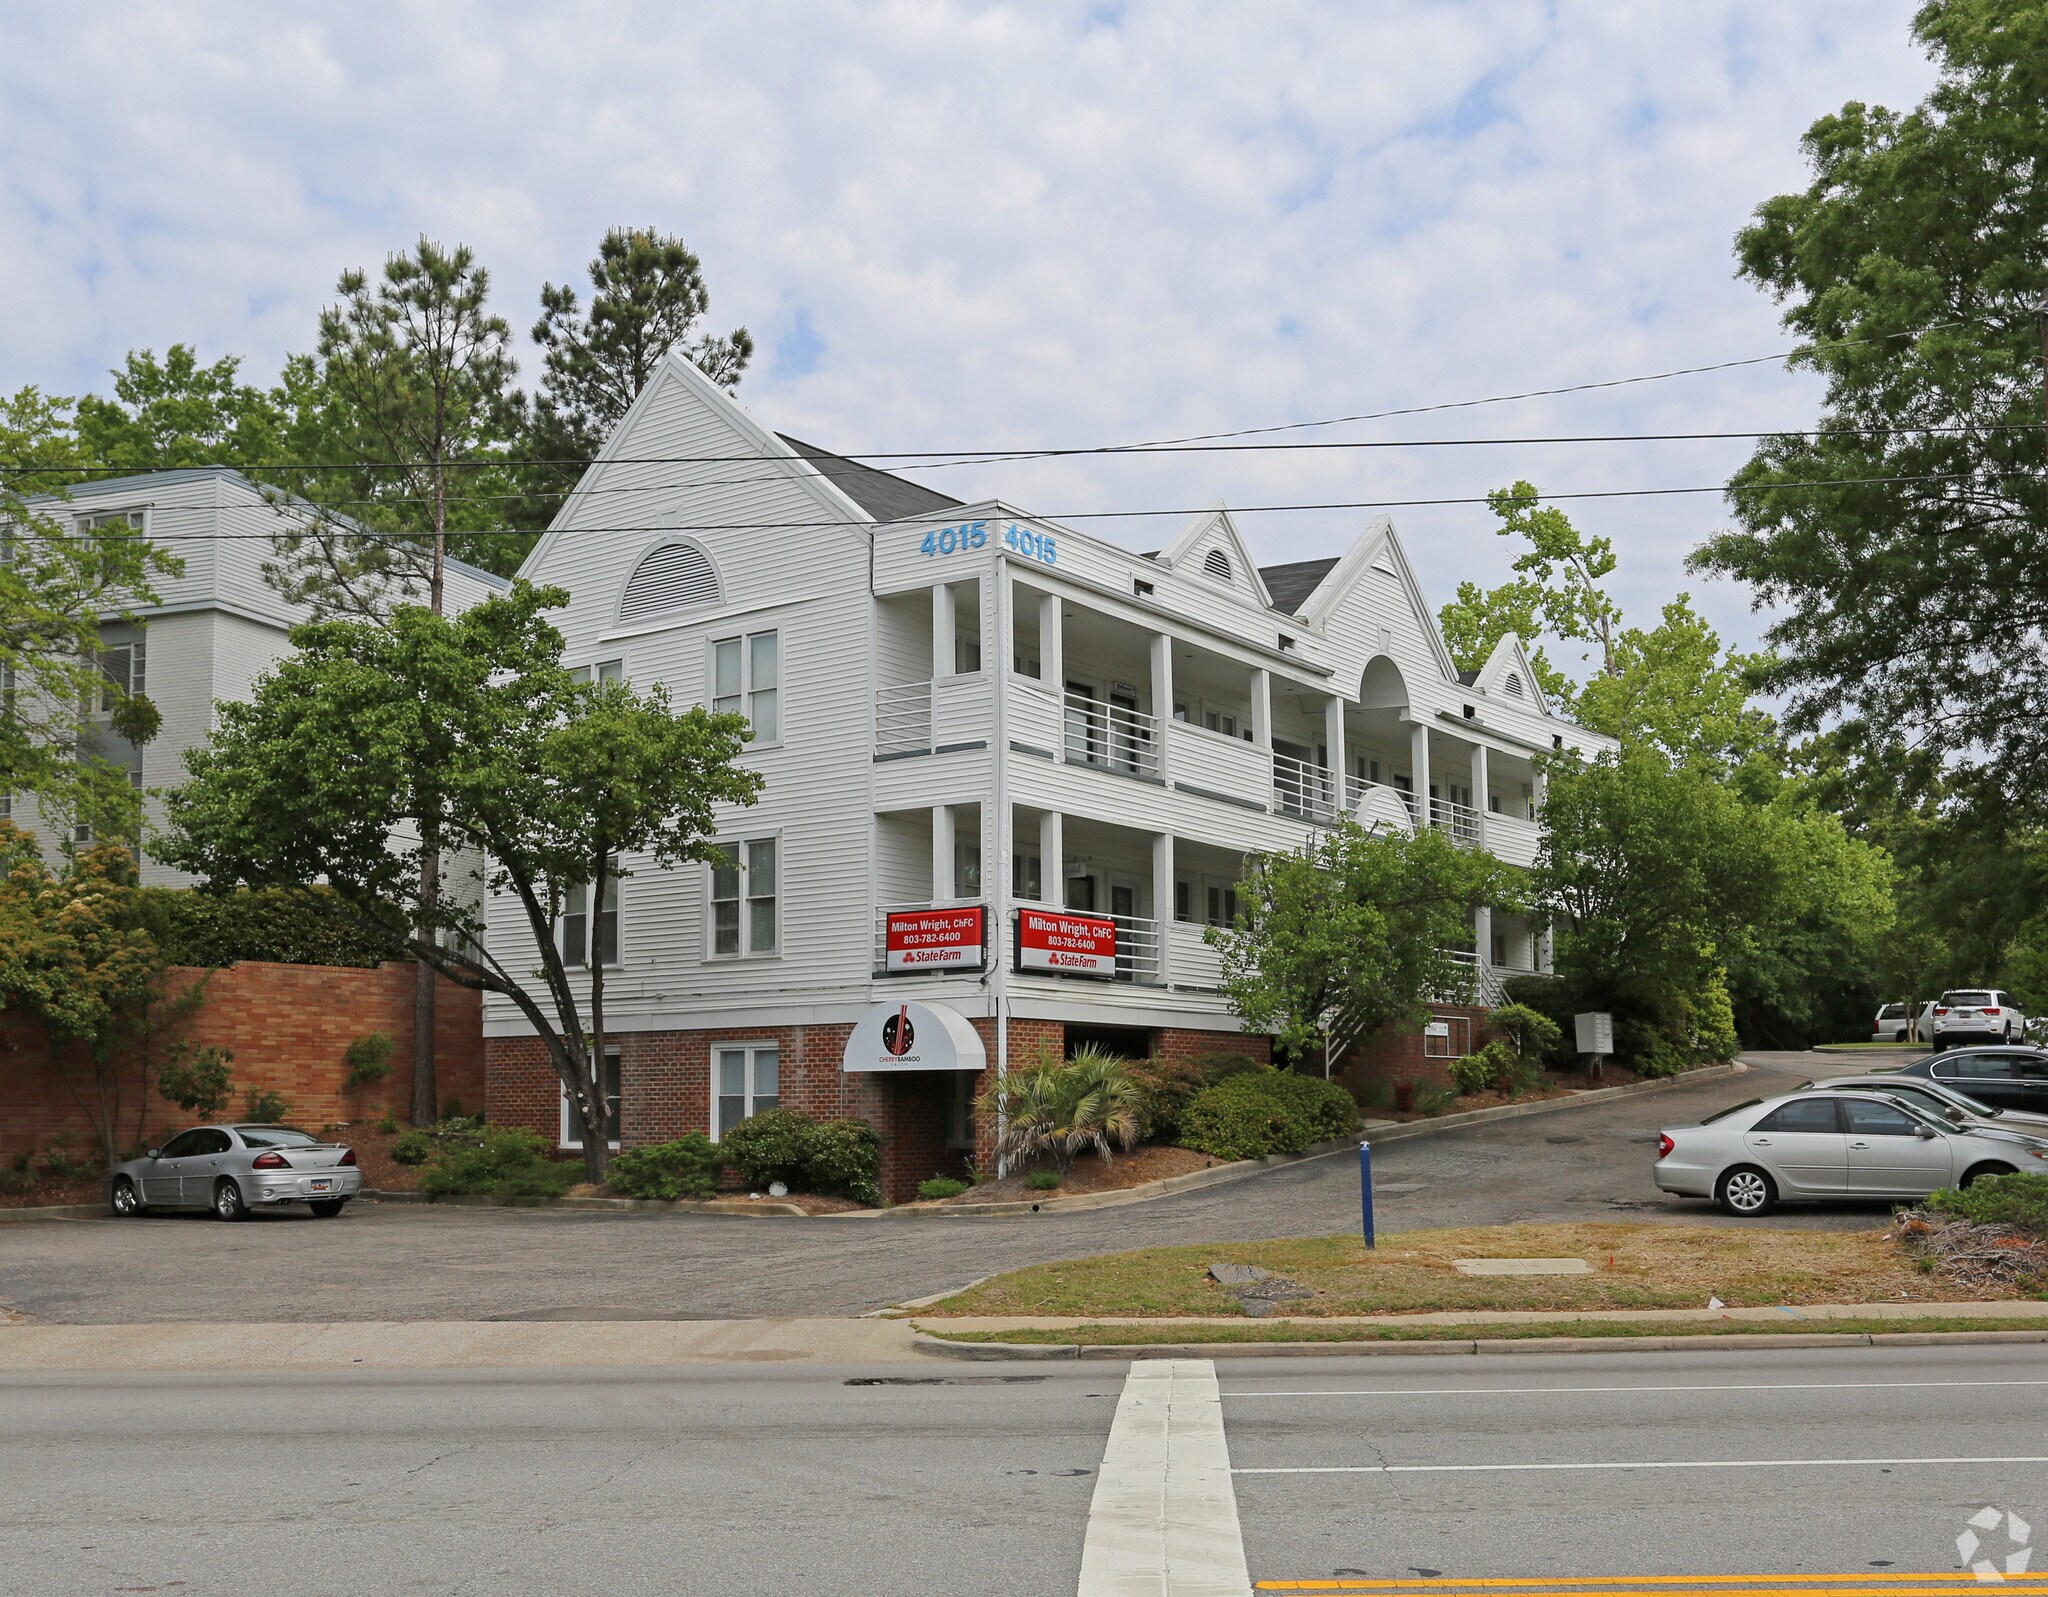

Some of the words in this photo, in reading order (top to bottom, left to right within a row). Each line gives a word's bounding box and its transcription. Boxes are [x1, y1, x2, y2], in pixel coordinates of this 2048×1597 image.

[920, 520, 987, 557] 4015
[1005, 523, 1057, 564] 4015
[891, 921, 918, 933] Milton
[919, 919, 951, 931] Wright,
[953, 918, 974, 928] ChFC
[1029, 916, 1057, 933] Milton
[1059, 920, 1091, 938] Wright,
[1092, 926, 1112, 939] ChFC
[903, 932, 961, 944] 803-782-6400
[1047, 935, 1096, 950] 803-782-6400
